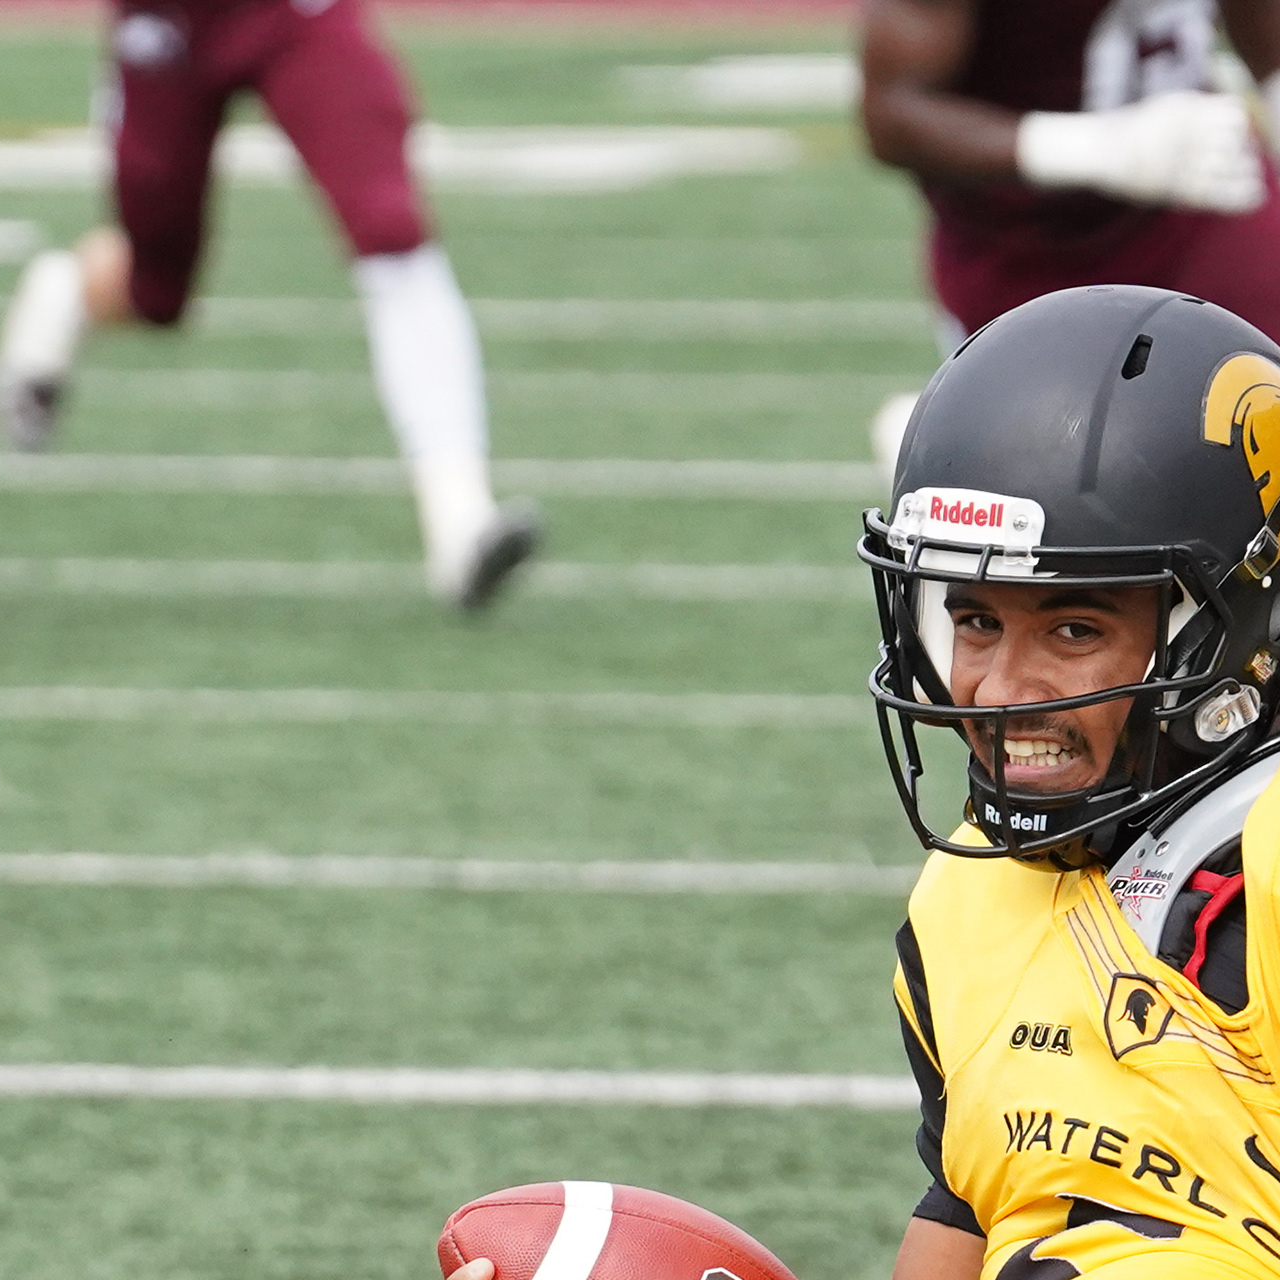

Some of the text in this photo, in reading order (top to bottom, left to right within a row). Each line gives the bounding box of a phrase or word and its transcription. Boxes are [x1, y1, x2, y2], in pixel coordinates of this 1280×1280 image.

[930, 496, 1004, 527] Riddell
[985, 803, 1047, 831] Ridell
[1009, 1021, 1073, 1056] OUA
